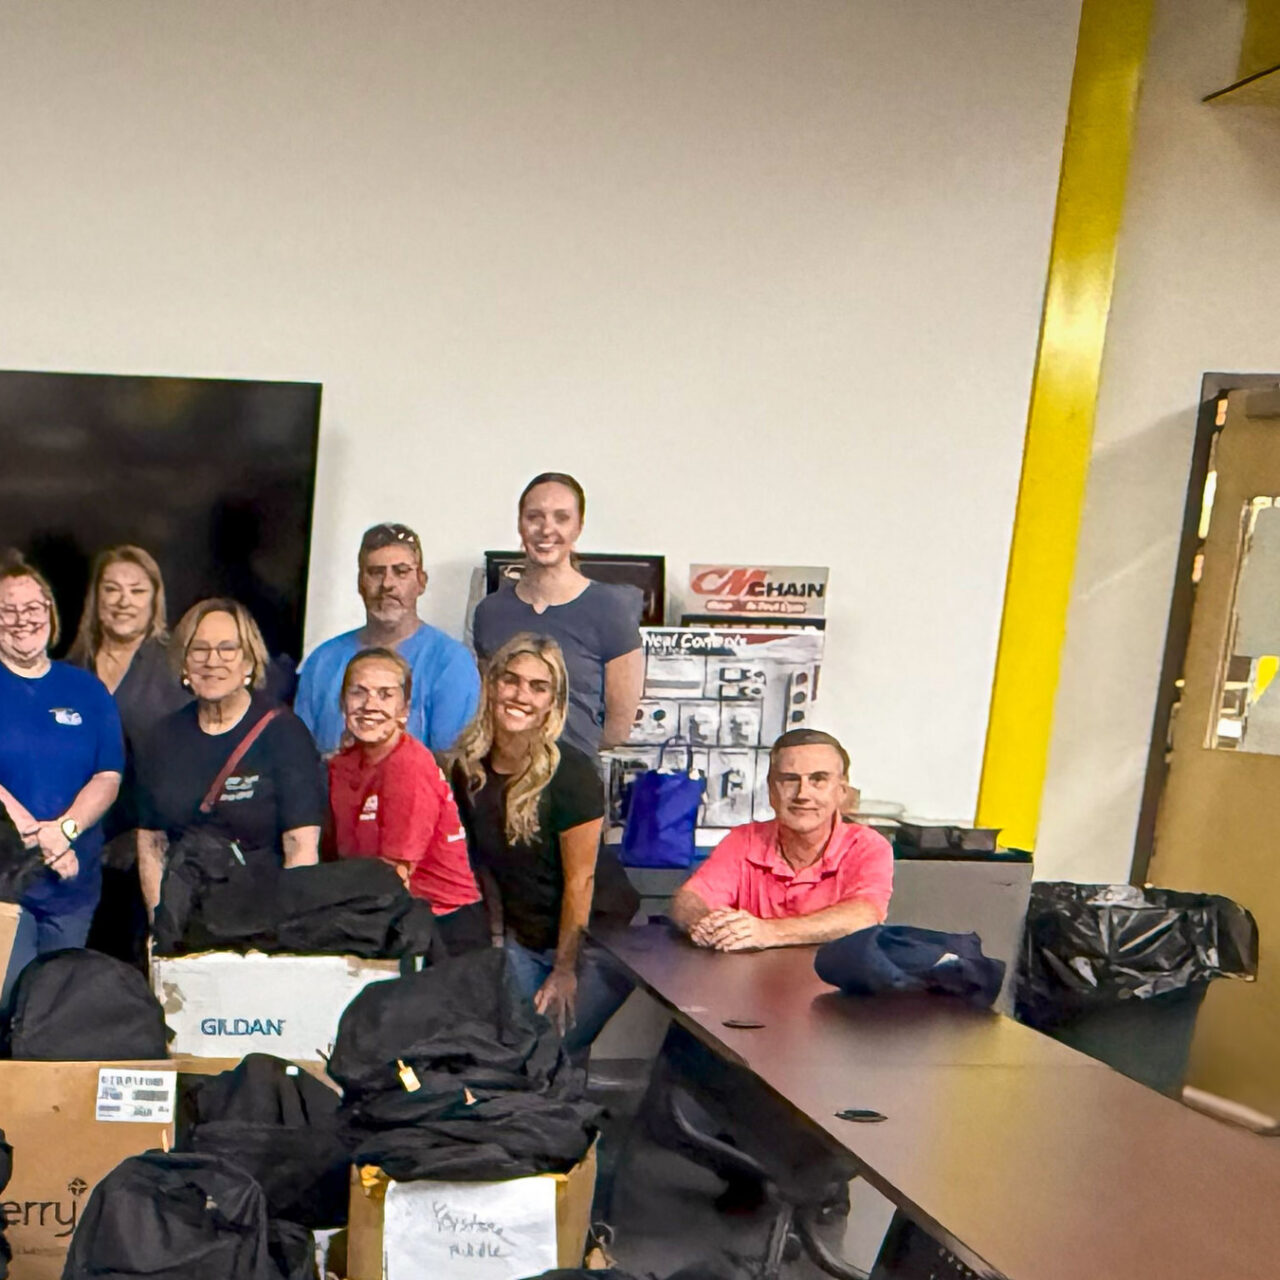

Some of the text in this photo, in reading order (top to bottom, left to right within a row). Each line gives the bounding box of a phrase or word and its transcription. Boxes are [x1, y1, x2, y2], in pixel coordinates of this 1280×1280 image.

[746, 581, 824, 598] CHAIN
[200, 1018, 286, 1036] GILDAN
[0, 1200, 77, 1238] erry
